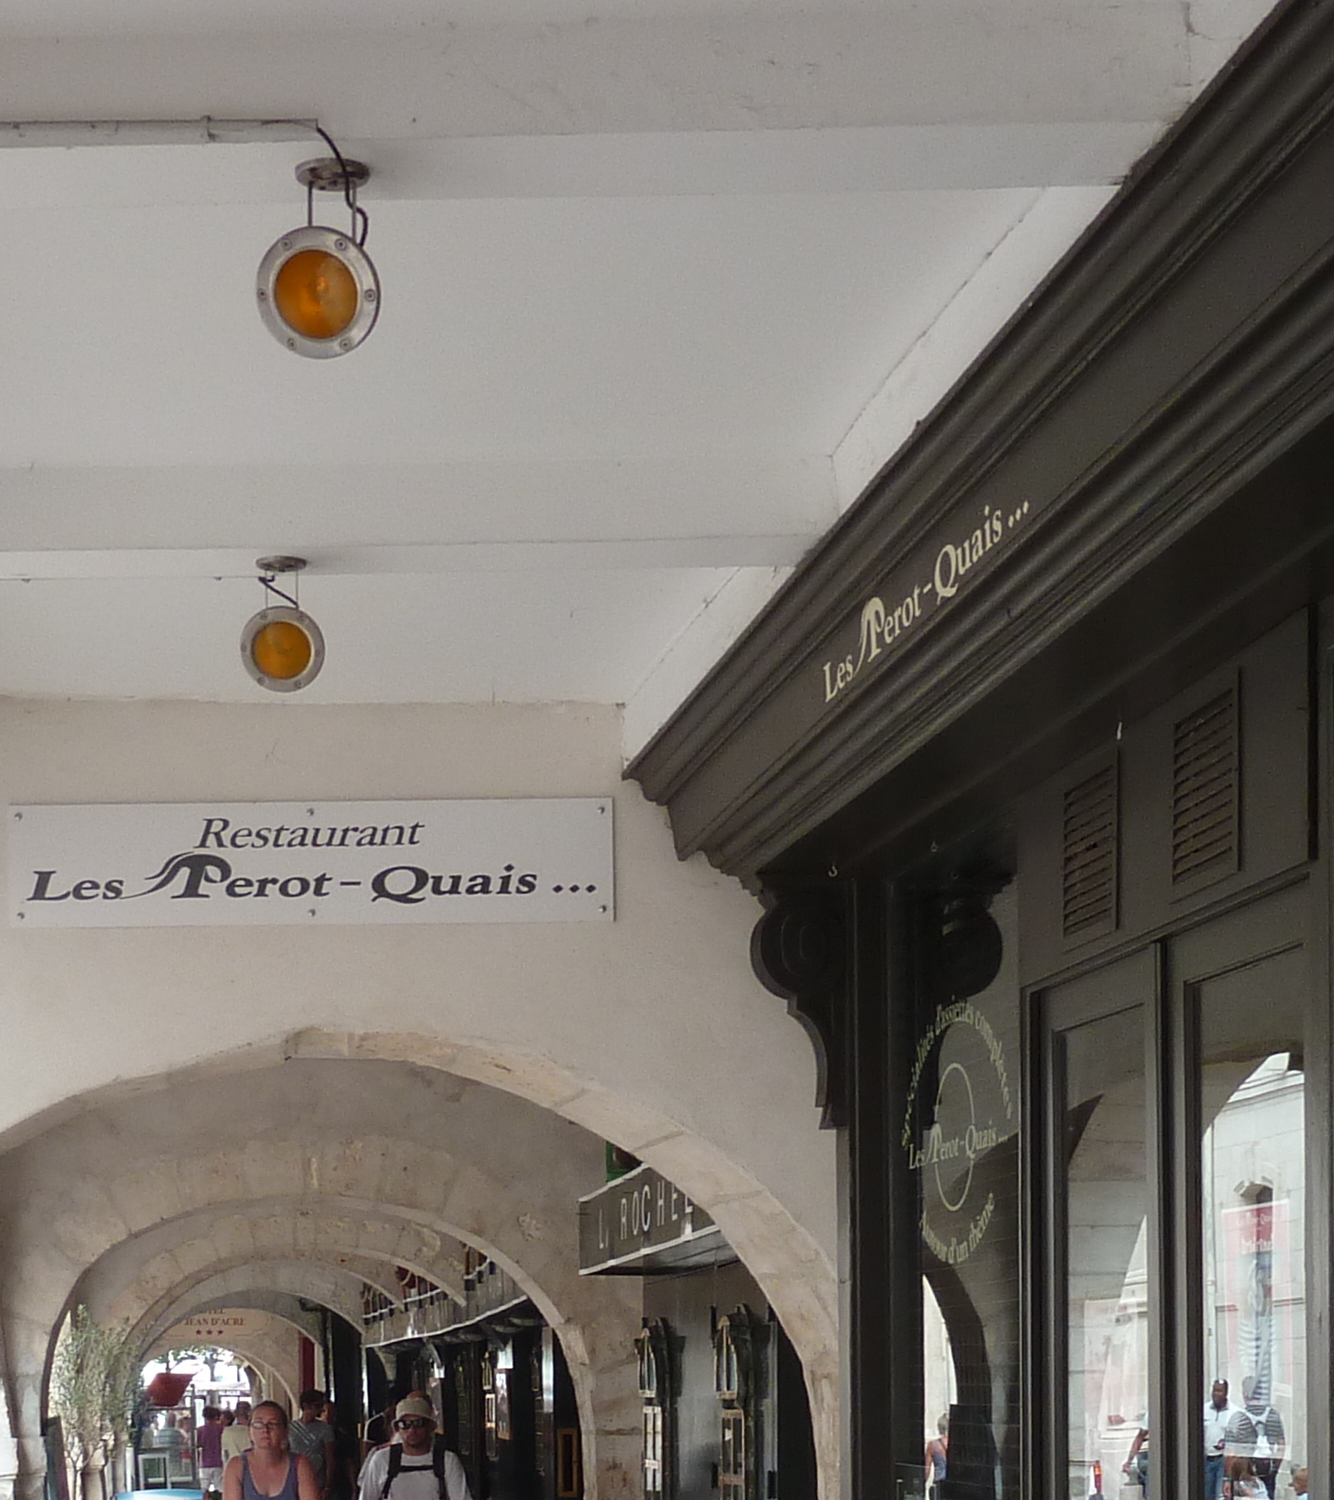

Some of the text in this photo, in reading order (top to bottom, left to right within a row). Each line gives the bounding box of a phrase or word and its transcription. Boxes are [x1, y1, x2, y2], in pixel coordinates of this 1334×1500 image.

[823, 655, 854, 702] Les
[194, 816, 425, 850] Restaurant
[25, 870, 125, 902] Les
[909, 1143, 925, 1170] Les
